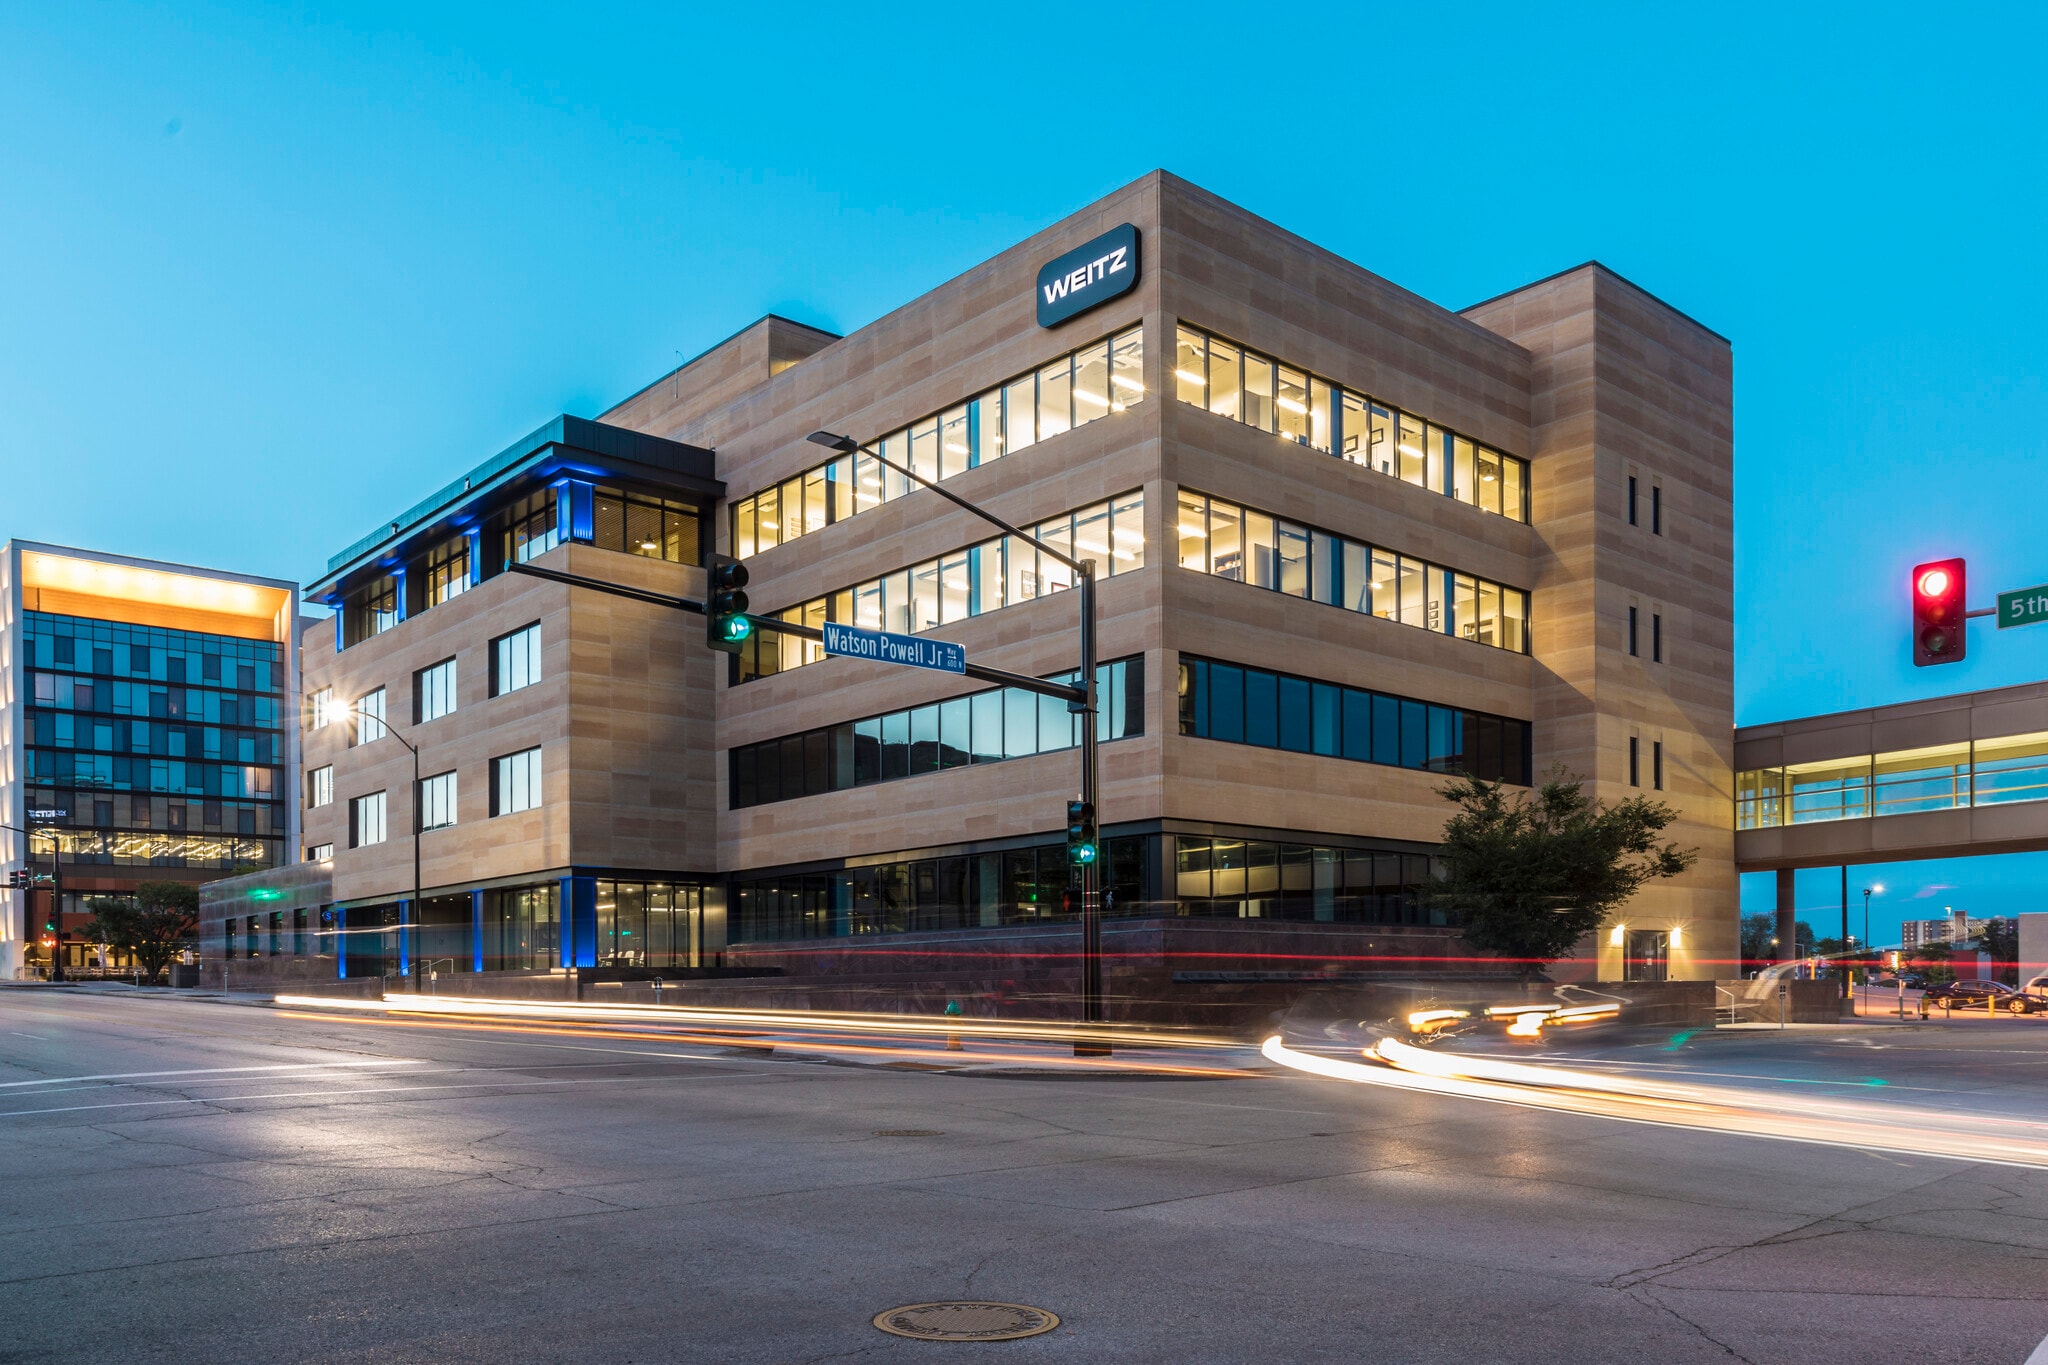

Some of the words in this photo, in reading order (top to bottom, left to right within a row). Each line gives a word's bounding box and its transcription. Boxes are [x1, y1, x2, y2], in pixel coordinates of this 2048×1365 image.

[1043, 246, 1127, 304] WEITZ
[2011, 595, 2048, 618] 5th
[827, 627, 877, 657] Watson
[880, 636, 924, 664] Powell
[928, 645, 943, 667] Jr
